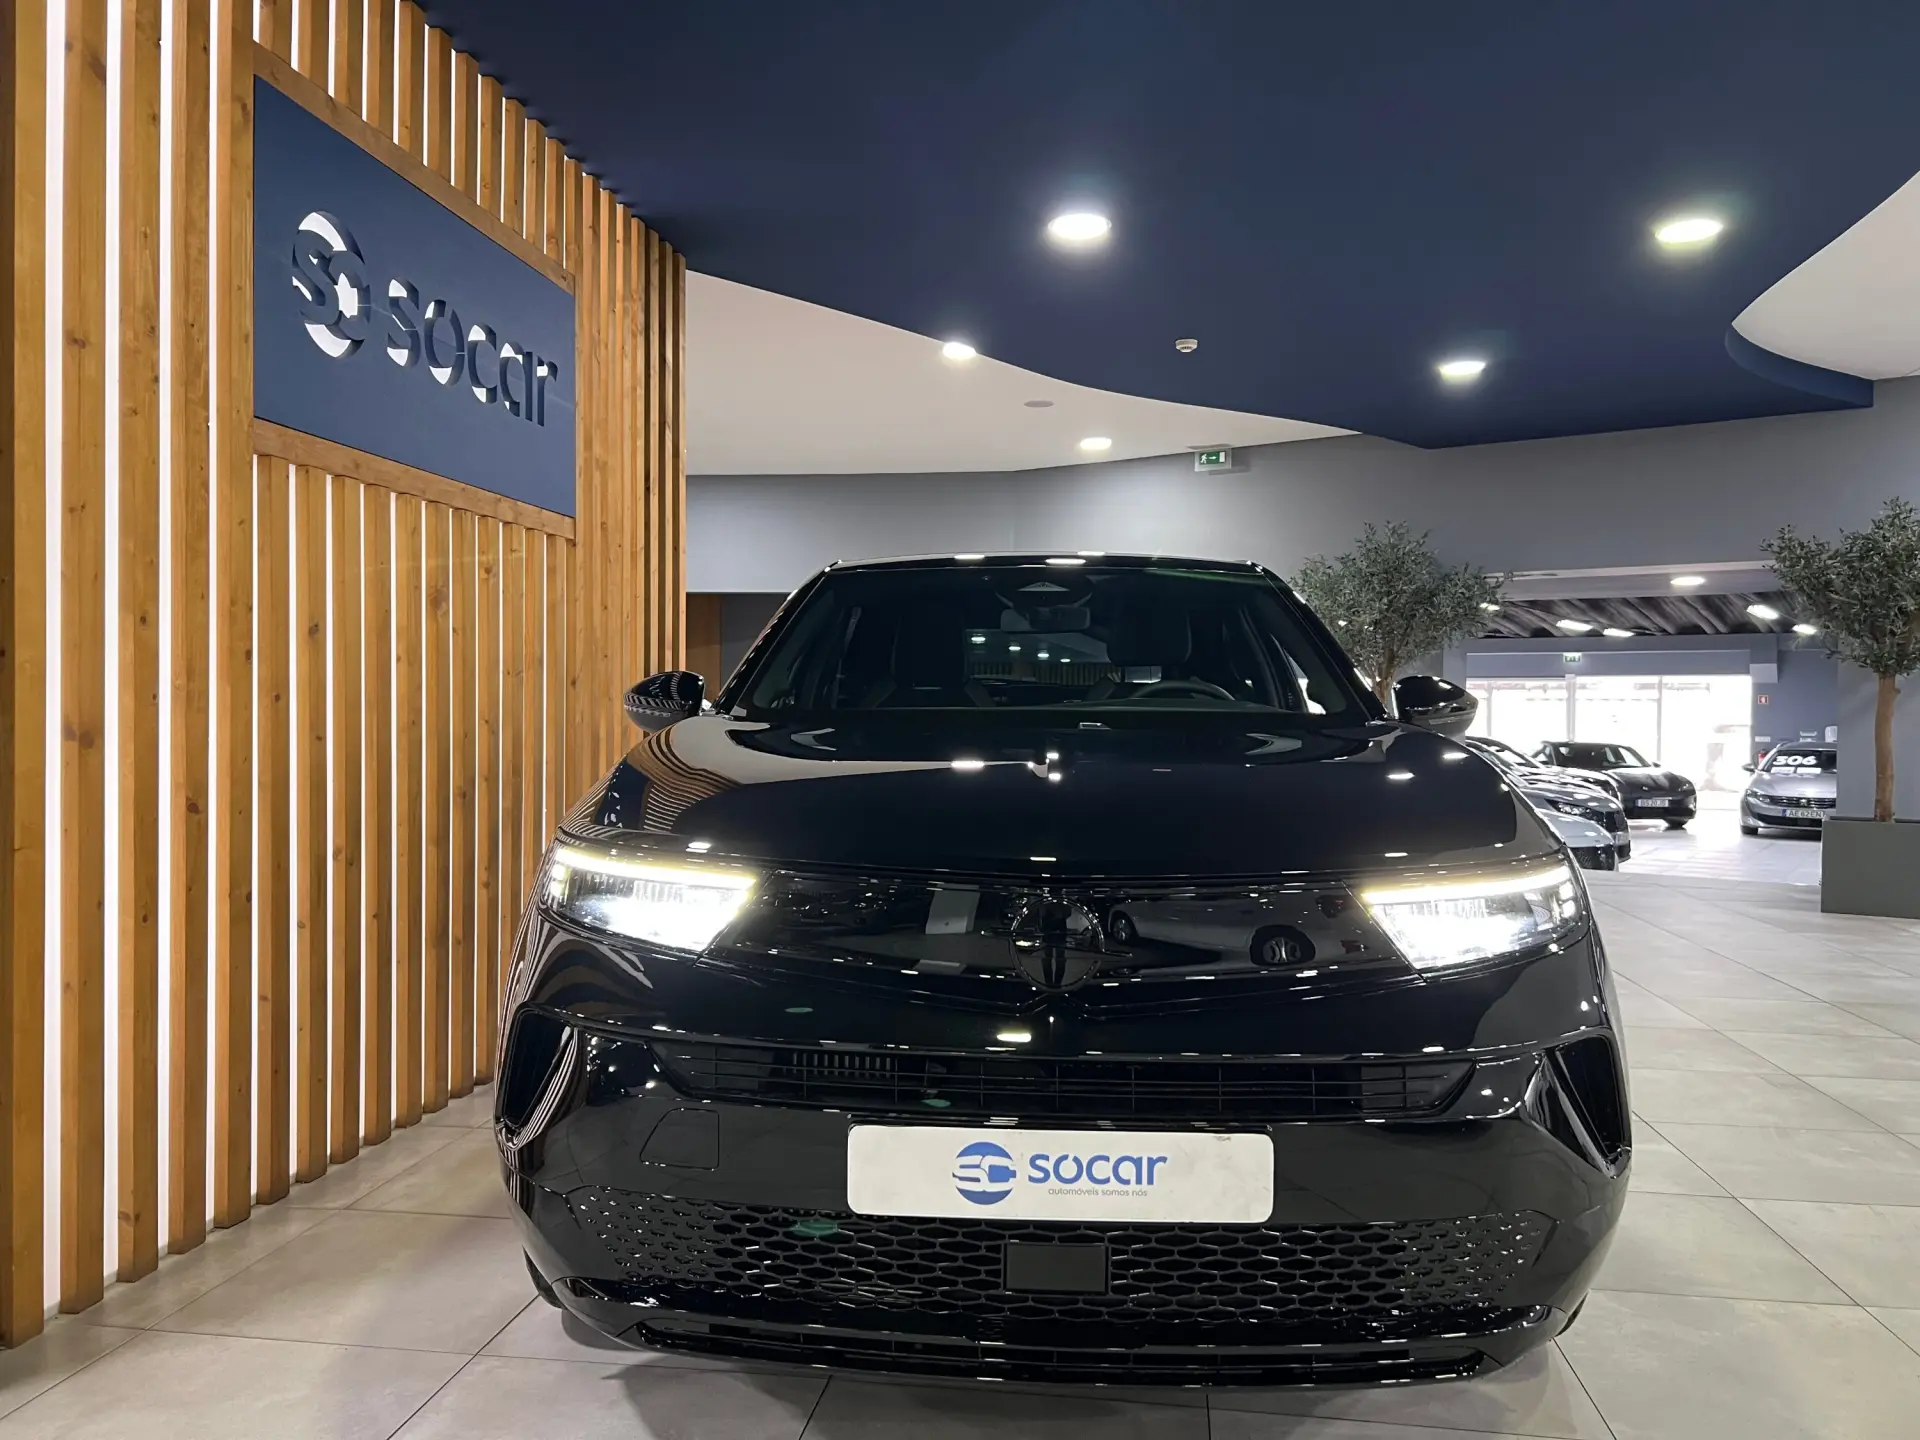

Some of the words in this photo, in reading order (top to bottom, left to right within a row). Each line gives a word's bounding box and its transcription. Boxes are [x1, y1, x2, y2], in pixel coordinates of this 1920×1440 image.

[386, 276, 558, 427] socar
[1027, 1153, 1168, 1186] socar
[1047, 1187, 1099, 1197] automóveis
[1101, 1189, 1130, 1197] somos
[1131, 1188, 1148, 1197] nós
